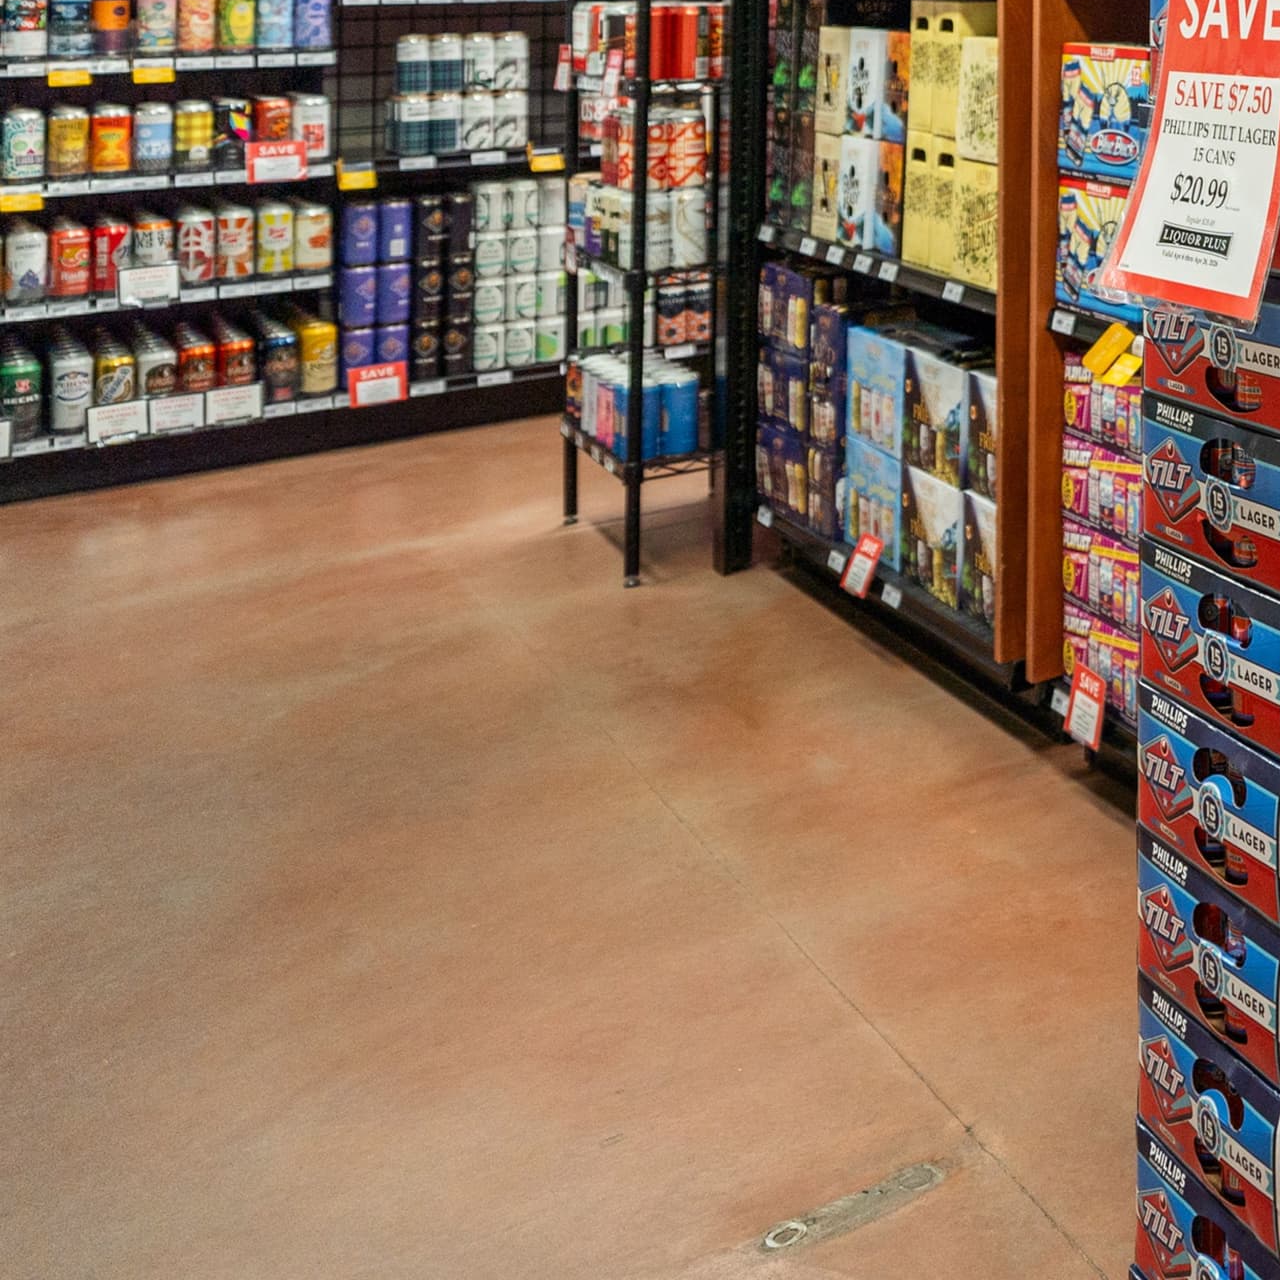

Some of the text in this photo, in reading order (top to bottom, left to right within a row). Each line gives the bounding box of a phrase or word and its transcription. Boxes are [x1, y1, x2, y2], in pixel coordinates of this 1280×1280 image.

[1174, 79, 1272, 115] SAVE $7.50
[1163, 118, 1276, 146] PHILLIPS TILT LAGER
[258, 144, 296, 157] SAVE
[1193, 147, 1236, 167] 15 CANS
[1170, 172, 1229, 210] $20.99
[1162, 228, 1228, 252] LIQUOR PLUS
[359, 366, 394, 380] SAVE
